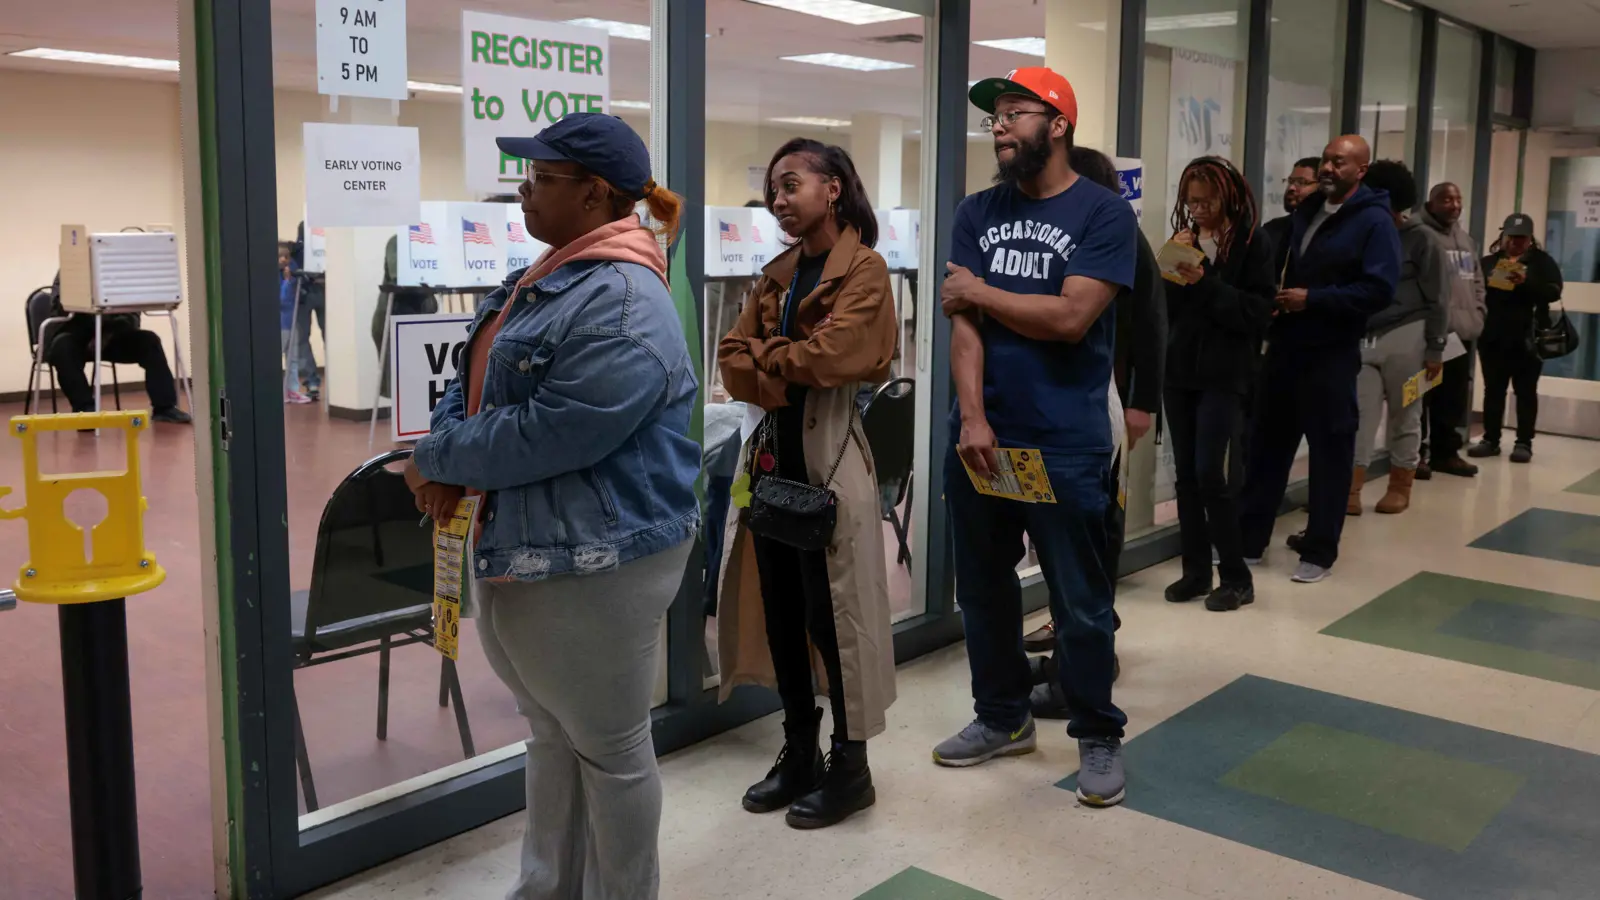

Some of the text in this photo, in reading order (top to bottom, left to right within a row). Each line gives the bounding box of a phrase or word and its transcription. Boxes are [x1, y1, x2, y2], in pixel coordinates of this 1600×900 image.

[340, 7, 376, 28] 9 AM
[349, 36, 368, 54] TO
[471, 30, 604, 76] REGISTER
[341, 63, 377, 82] 5 PM
[471, 87, 603, 123] to VOTE
[325, 160, 402, 171] EARLY VOTING
[343, 181, 387, 191] CENTER
[979, 219, 1077, 262] OCCASIONAL
[412, 259, 438, 269] VOTE
[467, 259, 496, 270] VOTE
[723, 254, 744, 262] VOTE
[989, 247, 1054, 280] ADULT
